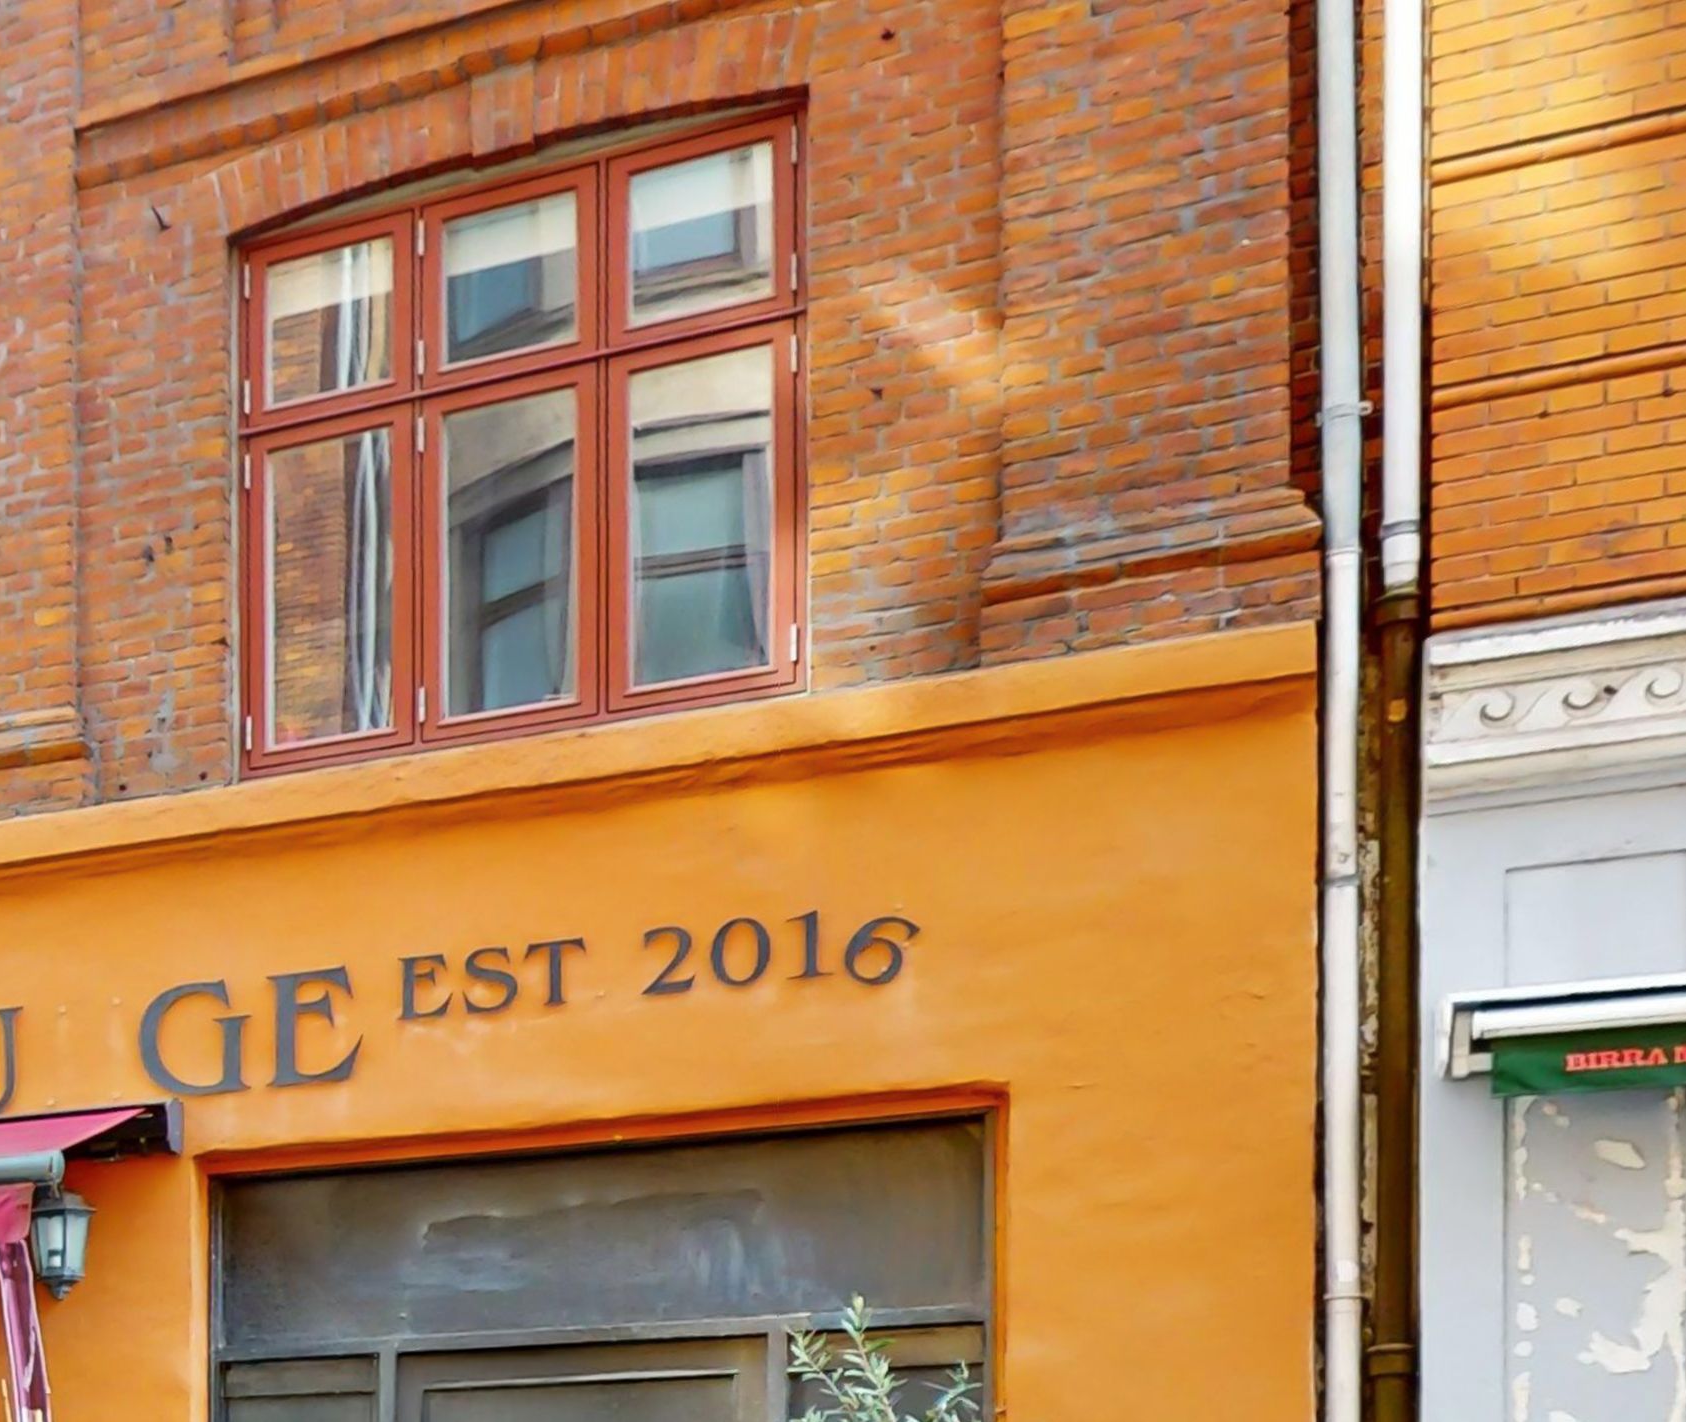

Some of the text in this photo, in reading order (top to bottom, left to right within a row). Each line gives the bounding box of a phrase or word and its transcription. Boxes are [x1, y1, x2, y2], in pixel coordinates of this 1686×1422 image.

[397, 936, 586, 1021] EST
[640, 909, 921, 996] 2016
[1565, 1046, 1668, 1073] BIRRA
